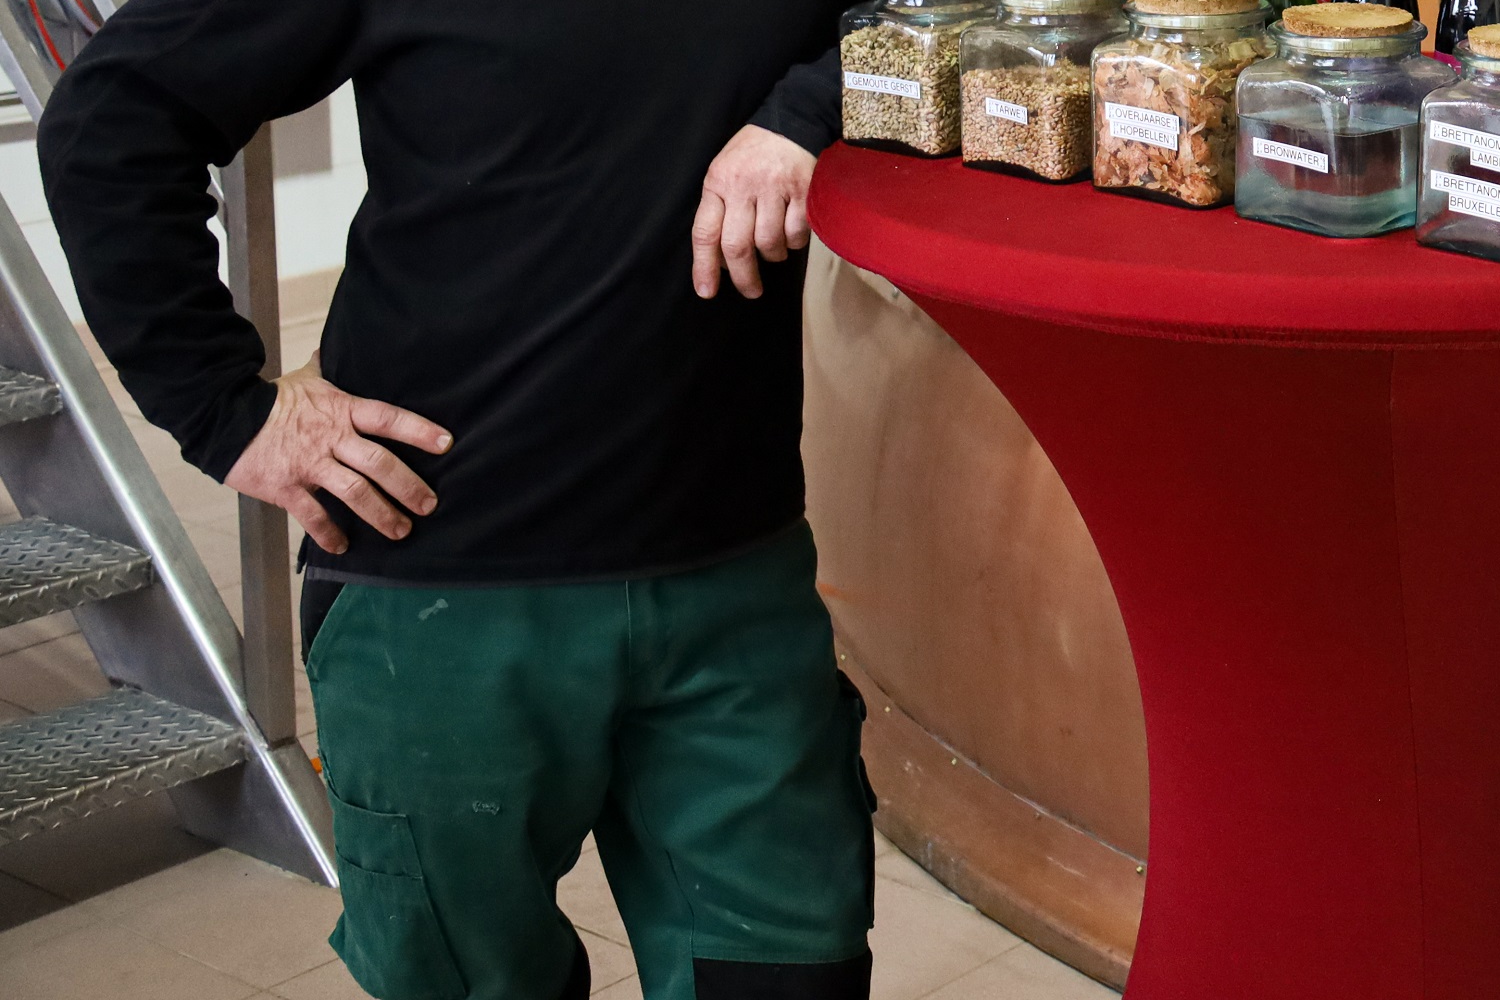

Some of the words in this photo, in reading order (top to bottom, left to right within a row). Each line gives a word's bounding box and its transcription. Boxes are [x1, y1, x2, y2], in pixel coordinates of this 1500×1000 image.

[852, 76, 888, 89] GEMOUTE
[891, 82, 913, 93] GERST
[995, 103, 1021, 118] TARWE
[1115, 108, 1171, 128] OVERJAARSE
[1120, 125, 1170, 143] HOPBELLEN
[1264, 144, 1319, 165] BRONWATER
